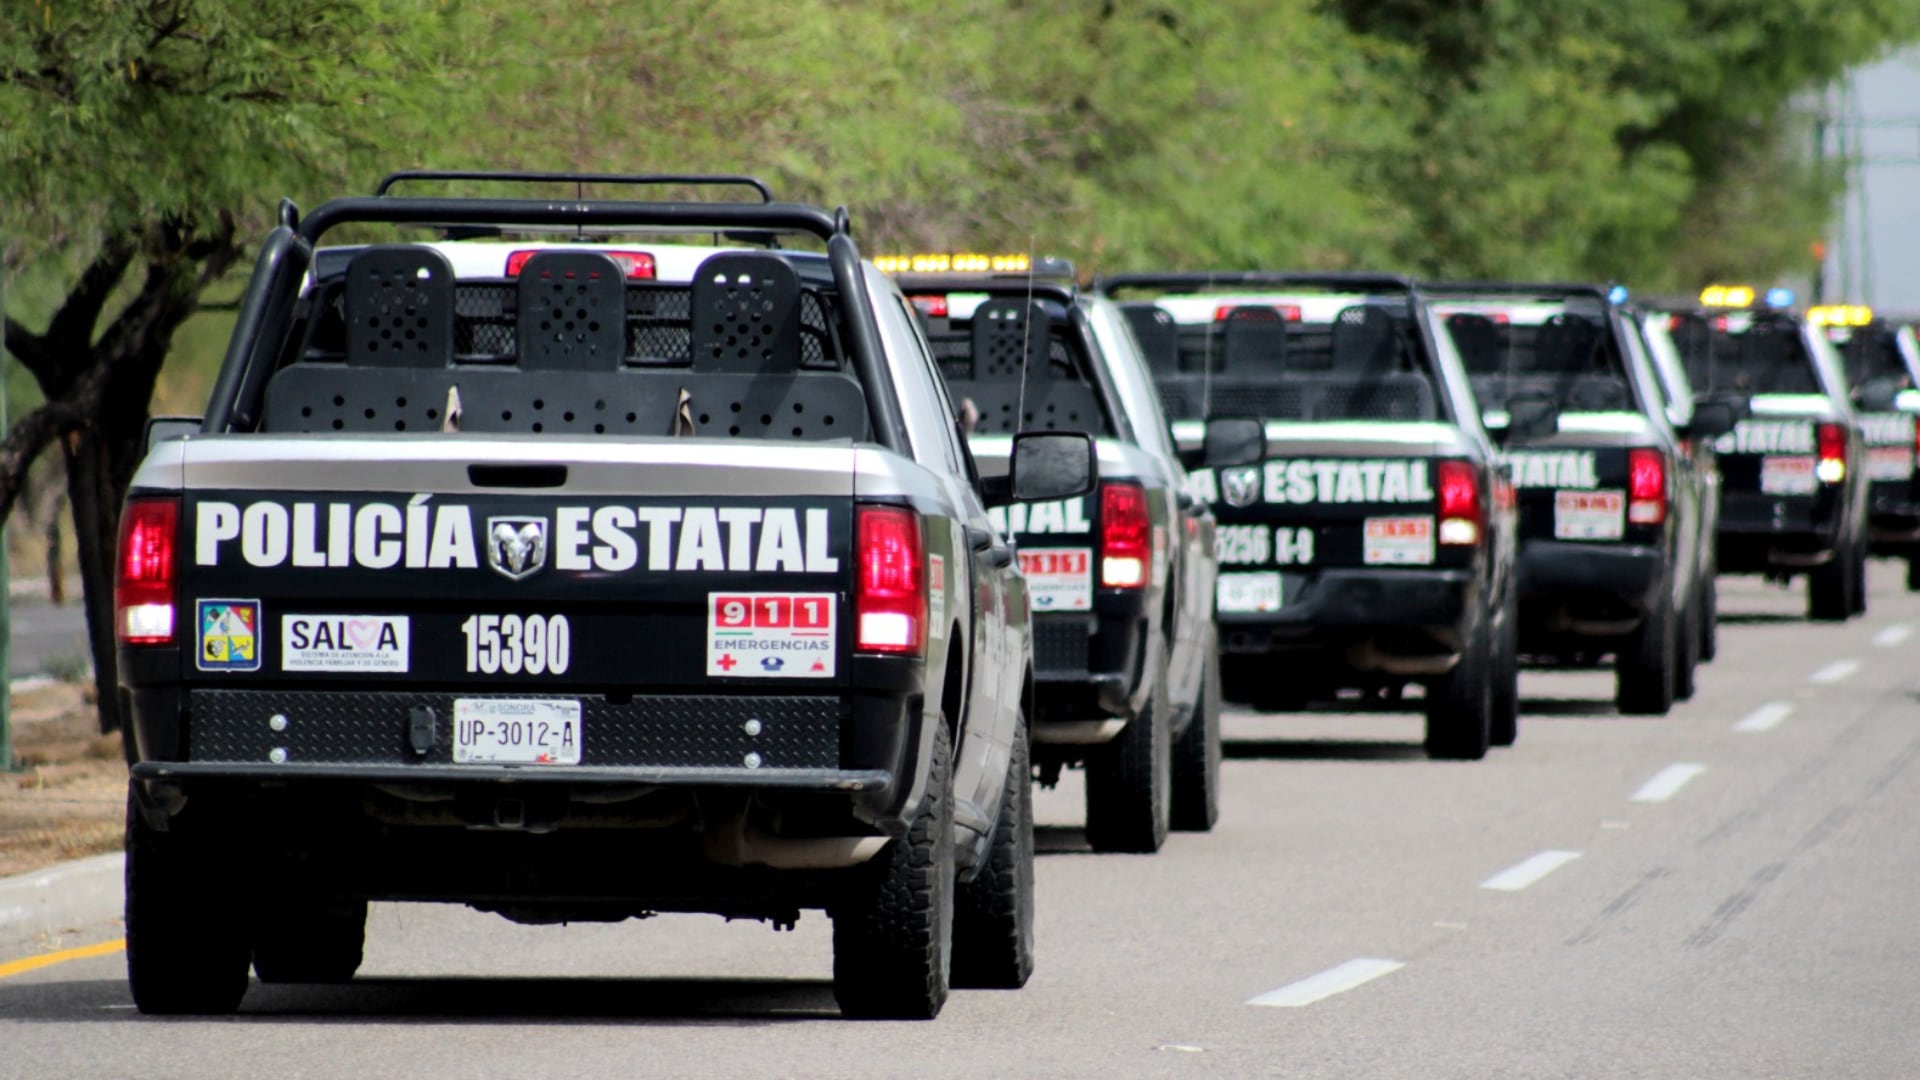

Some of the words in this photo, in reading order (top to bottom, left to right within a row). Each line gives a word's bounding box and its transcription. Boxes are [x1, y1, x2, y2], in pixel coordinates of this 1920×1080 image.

[1264, 460, 1434, 503] ESTATAL
[1508, 452, 1599, 488] TATAL
[195, 493, 479, 568] POLICÍA
[555, 506, 839, 573] ESTATAL
[1215, 525, 1270, 564] 5256
[722, 600, 819, 625] 911
[461, 614, 570, 675] 15390
[714, 639, 829, 651] EMERGENCIAS
[459, 720, 574, 747] UP-3012-A
